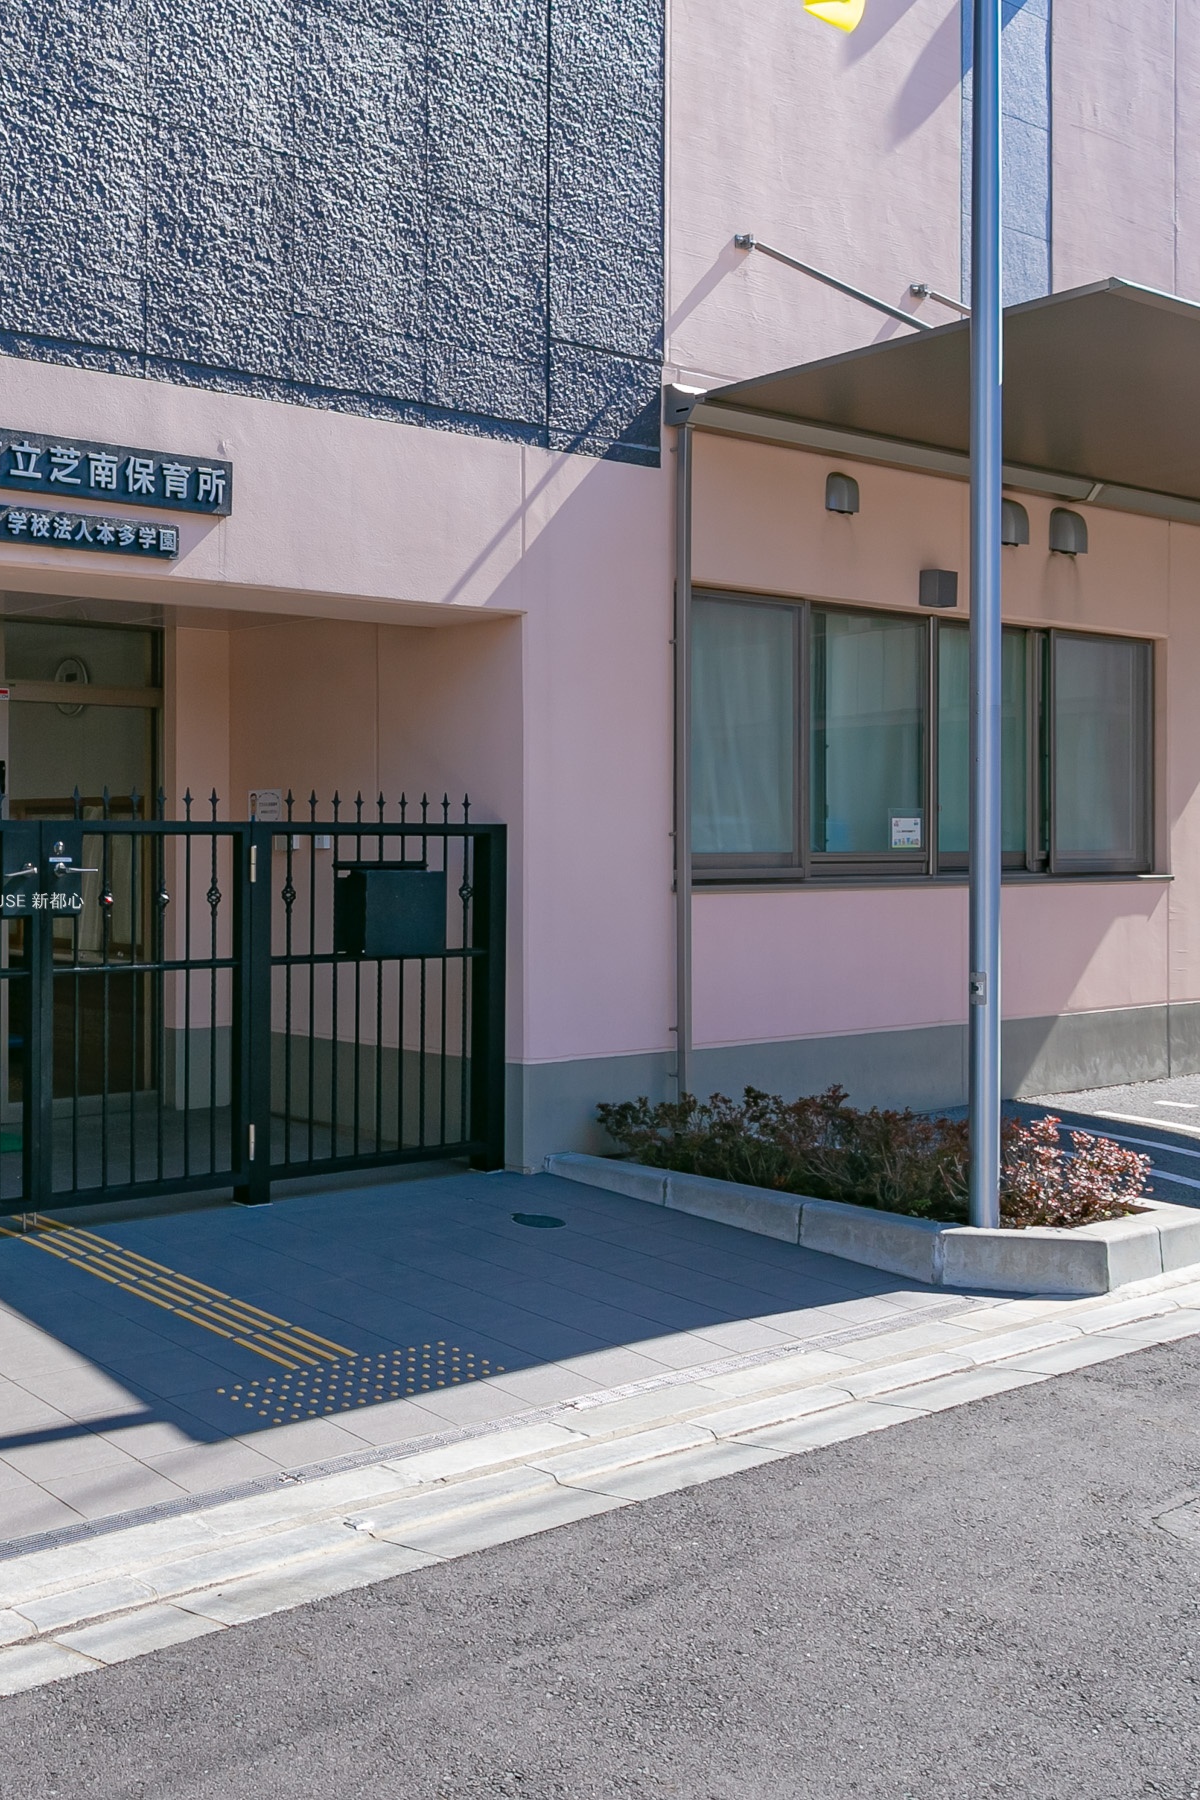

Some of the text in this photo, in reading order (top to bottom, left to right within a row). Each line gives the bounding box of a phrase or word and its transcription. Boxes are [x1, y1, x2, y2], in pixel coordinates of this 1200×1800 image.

[7, 511, 177, 552] 学校法人本多学園
